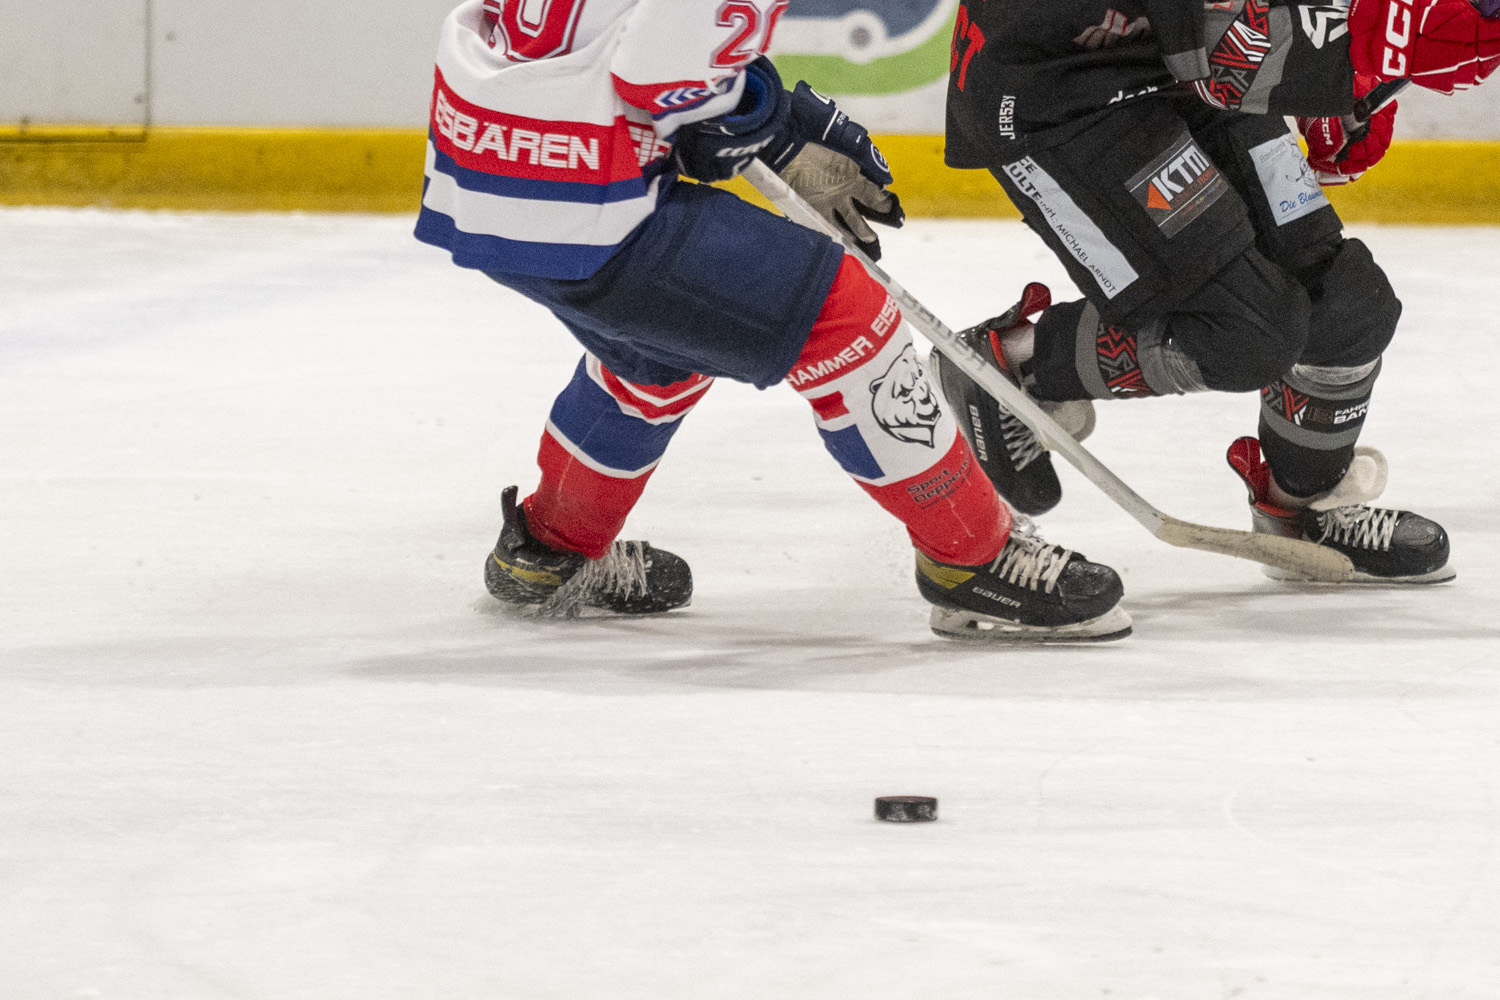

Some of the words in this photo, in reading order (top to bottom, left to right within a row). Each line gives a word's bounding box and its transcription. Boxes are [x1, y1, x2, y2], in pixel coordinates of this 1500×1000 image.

[1151, 144, 1210, 202] KTM
[1279, 200, 1298, 214] Die
[1056, 223, 1090, 264] MICHAEL
[1088, 264, 1117, 294] ARNDT
[786, 334, 874, 388] HAMMER
[969, 404, 989, 463] BAUER
[906, 468, 950, 495] Sport
[971, 586, 1022, 609] BAUER
